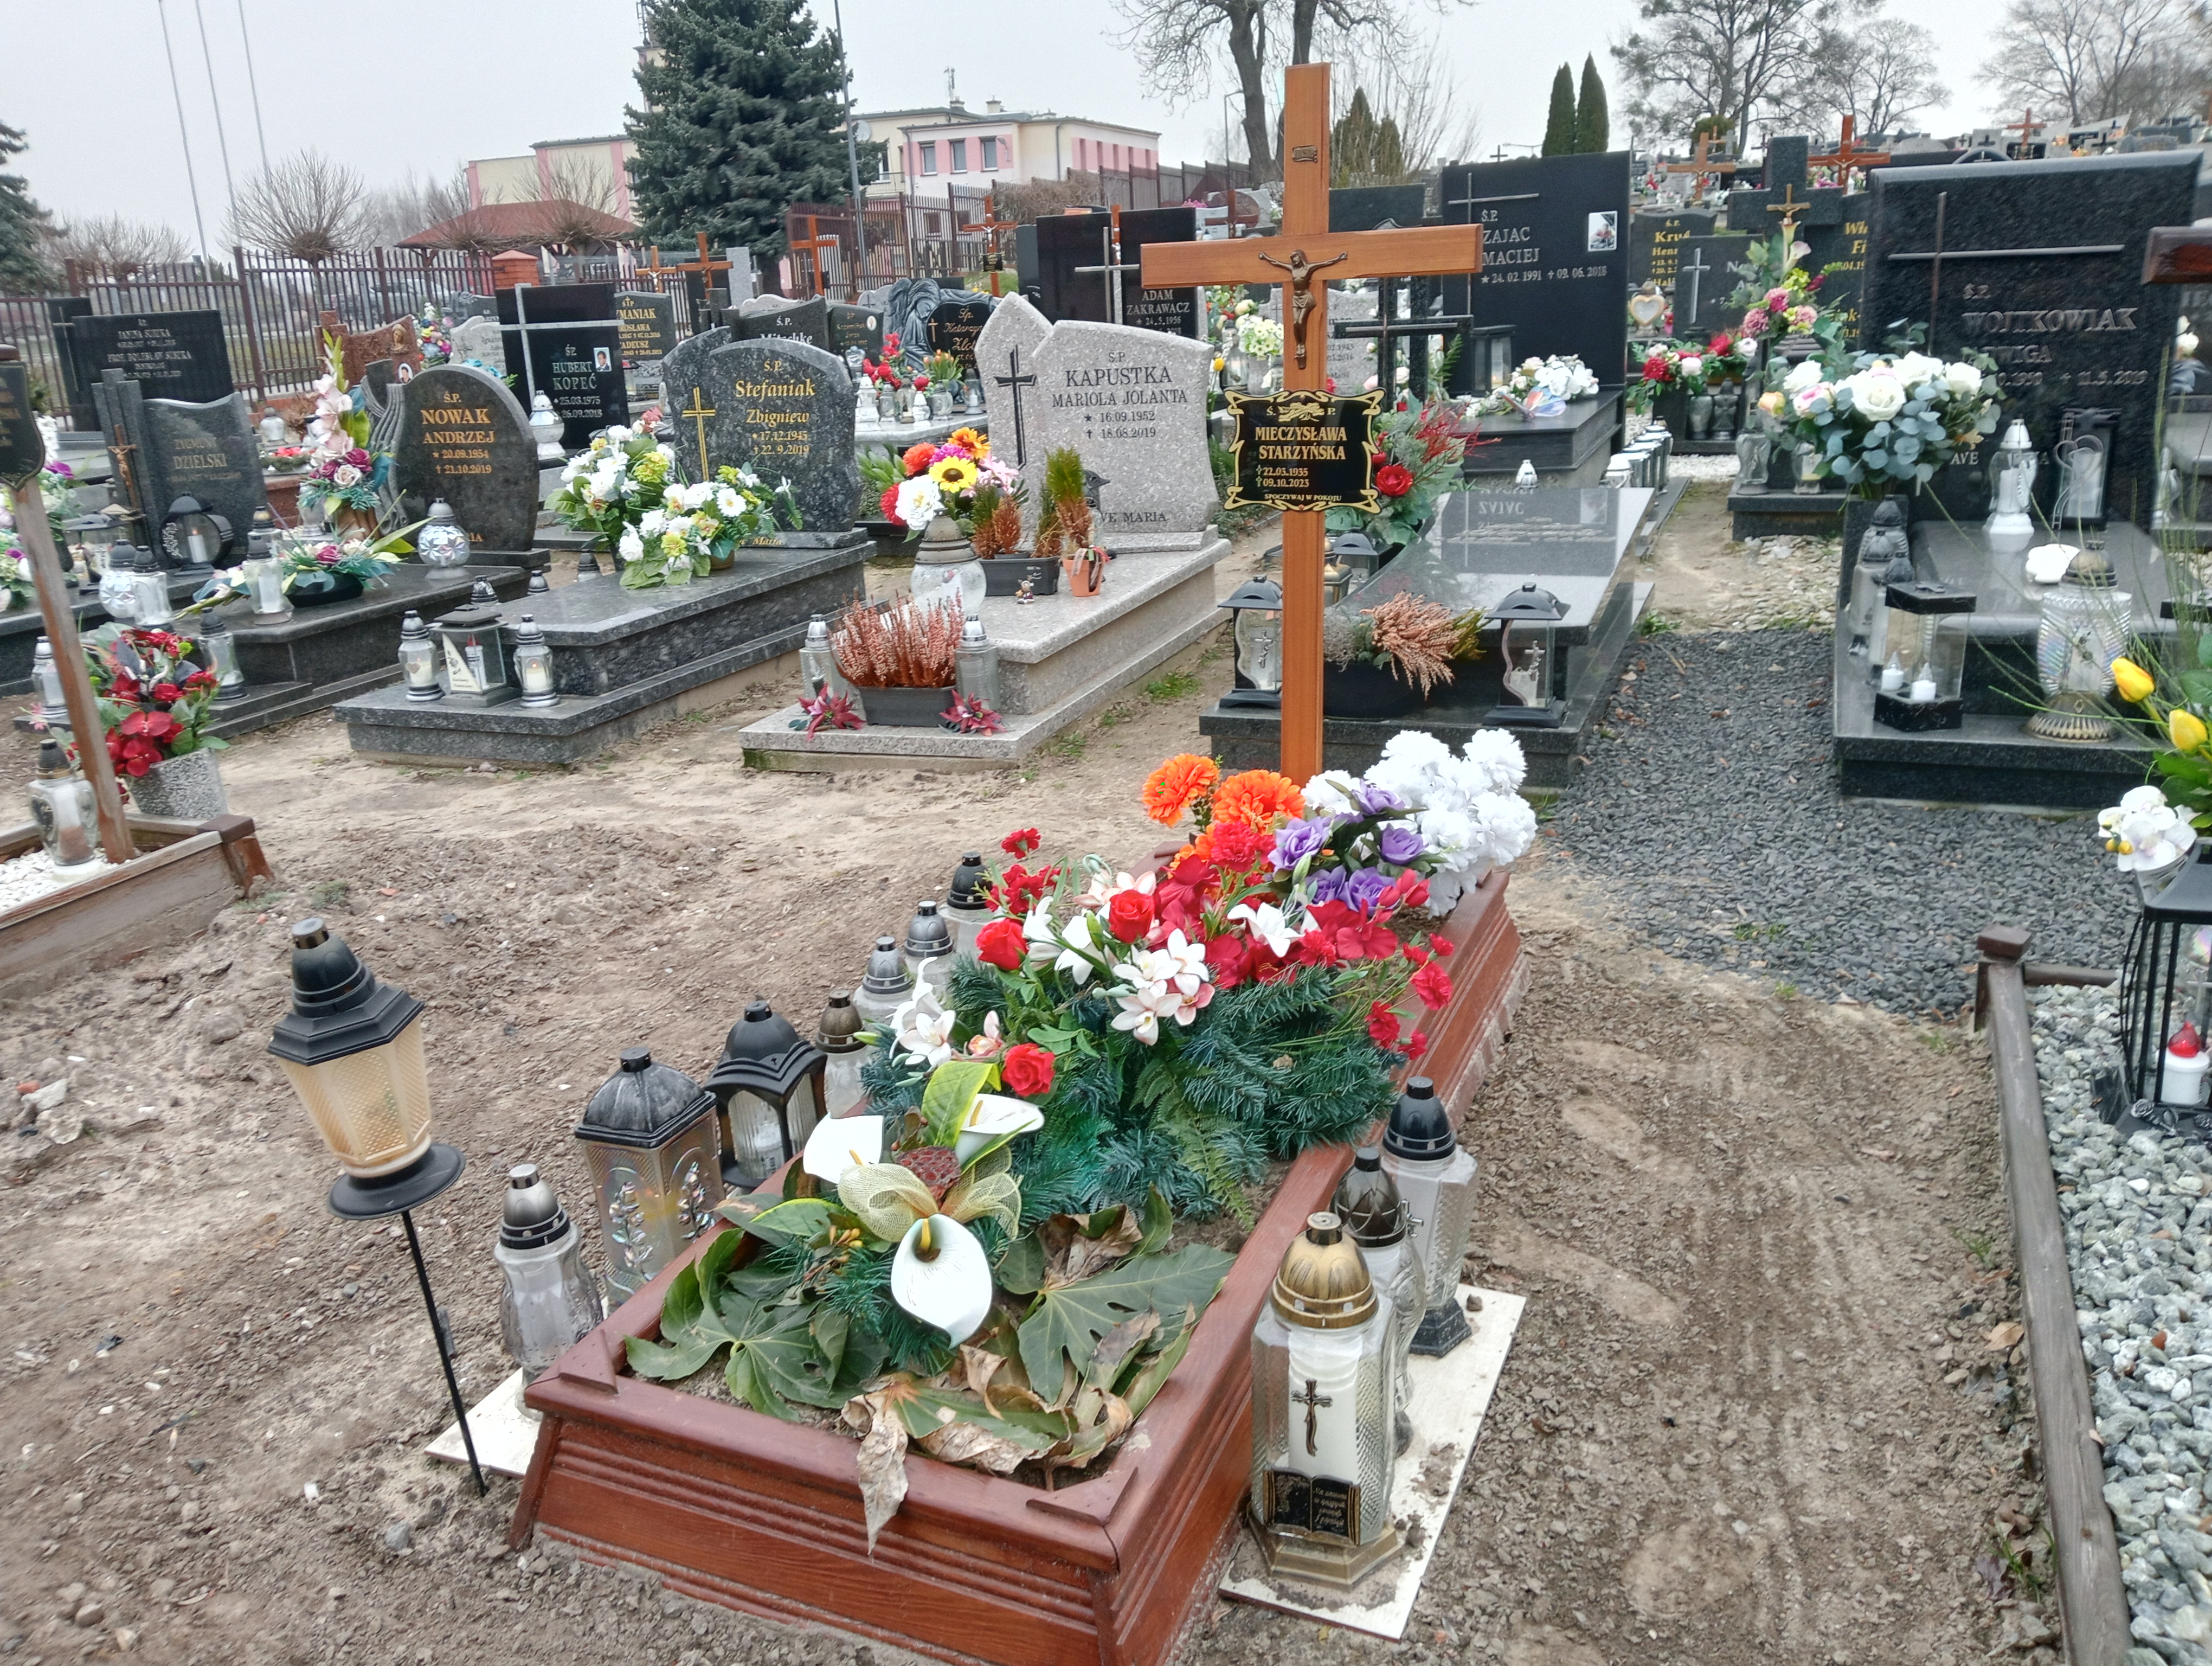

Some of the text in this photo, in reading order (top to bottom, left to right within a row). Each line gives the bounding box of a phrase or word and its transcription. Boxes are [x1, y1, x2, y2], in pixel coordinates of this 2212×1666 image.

[1482, 248, 1540, 266] MACIEJ
[1142, 290, 1173, 300] ADAM
[1127, 302, 1190, 315] ZAKRAWACZ
[620, 340, 649, 349] ADEUSZ
[760, 332, 813, 344] chke
[552, 361, 593, 373] HUBERT
[552, 373, 597, 390] KOPEĆ
[1065, 366, 1173, 387] KAPUSTKA
[735, 379, 816, 402] Stefaniak
[1052, 389, 1188, 407] MARIOLA JOLANTA
[421, 408, 491, 425] NOWAK
[746, 409, 810, 427] Zbigniew
[1101, 411, 1155, 422] 16.09.1952
[423, 431, 495, 444] ANDRZEJ
[1101, 427, 1156, 439] 18.08.2019
[1255, 426, 1347, 441] MIECZYSŁAWA
[442, 449, 489, 458] 20.09.1954
[1259, 442, 1346, 460] STARZYŃSKA
[172, 453, 228, 469] DZIELSKI
[1950, 451, 1979, 465] AVE
[444, 464, 492, 474] 21.10.2019
[1101, 512, 1168, 522] VE MARIA
